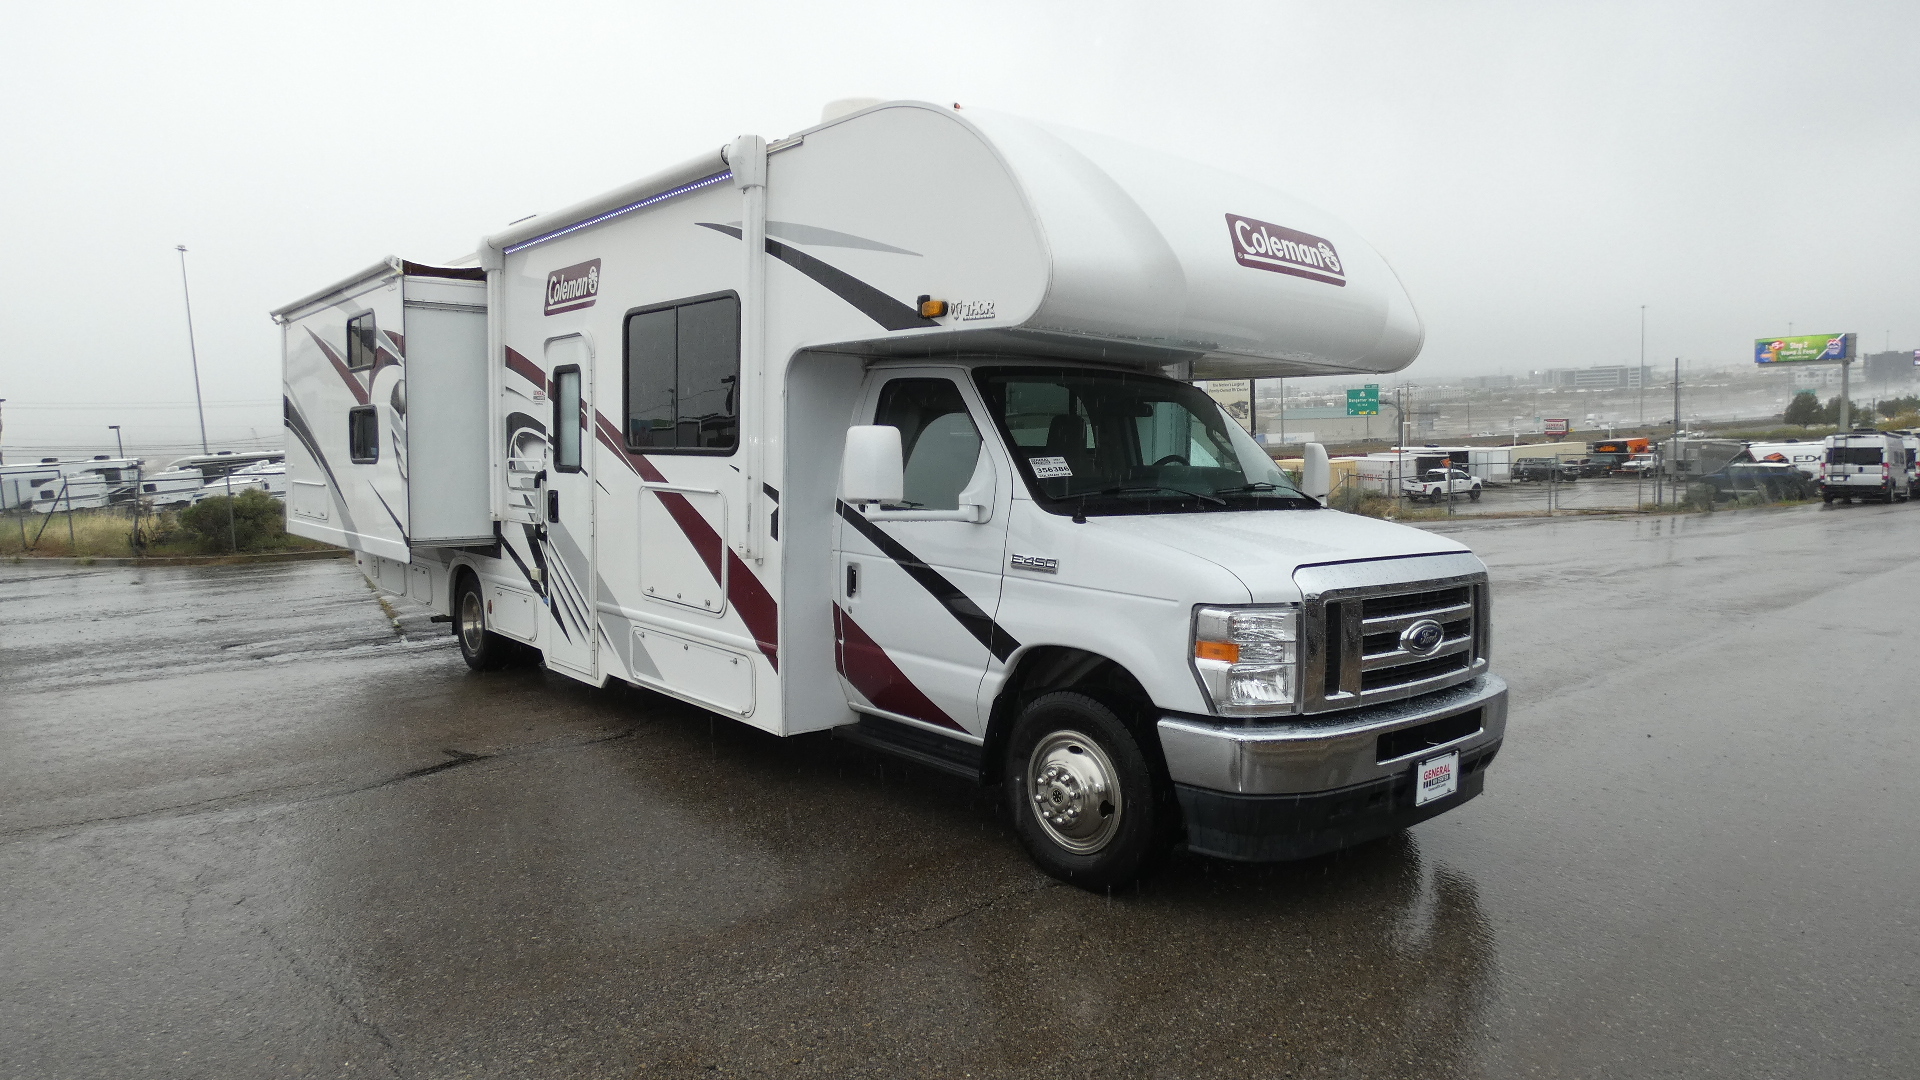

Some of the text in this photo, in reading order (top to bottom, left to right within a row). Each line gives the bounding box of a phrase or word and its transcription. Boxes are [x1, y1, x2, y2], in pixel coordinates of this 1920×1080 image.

[1235, 219, 1325, 268] Coleman
[548, 274, 588, 305] Coleman
[963, 300, 995, 317] THOR
[1789, 342, 1803, 350] Step
[1036, 466, 1070, 474] 356386
[1420, 629, 1438, 644] Ford
[1423, 763, 1450, 780] GENERAL
